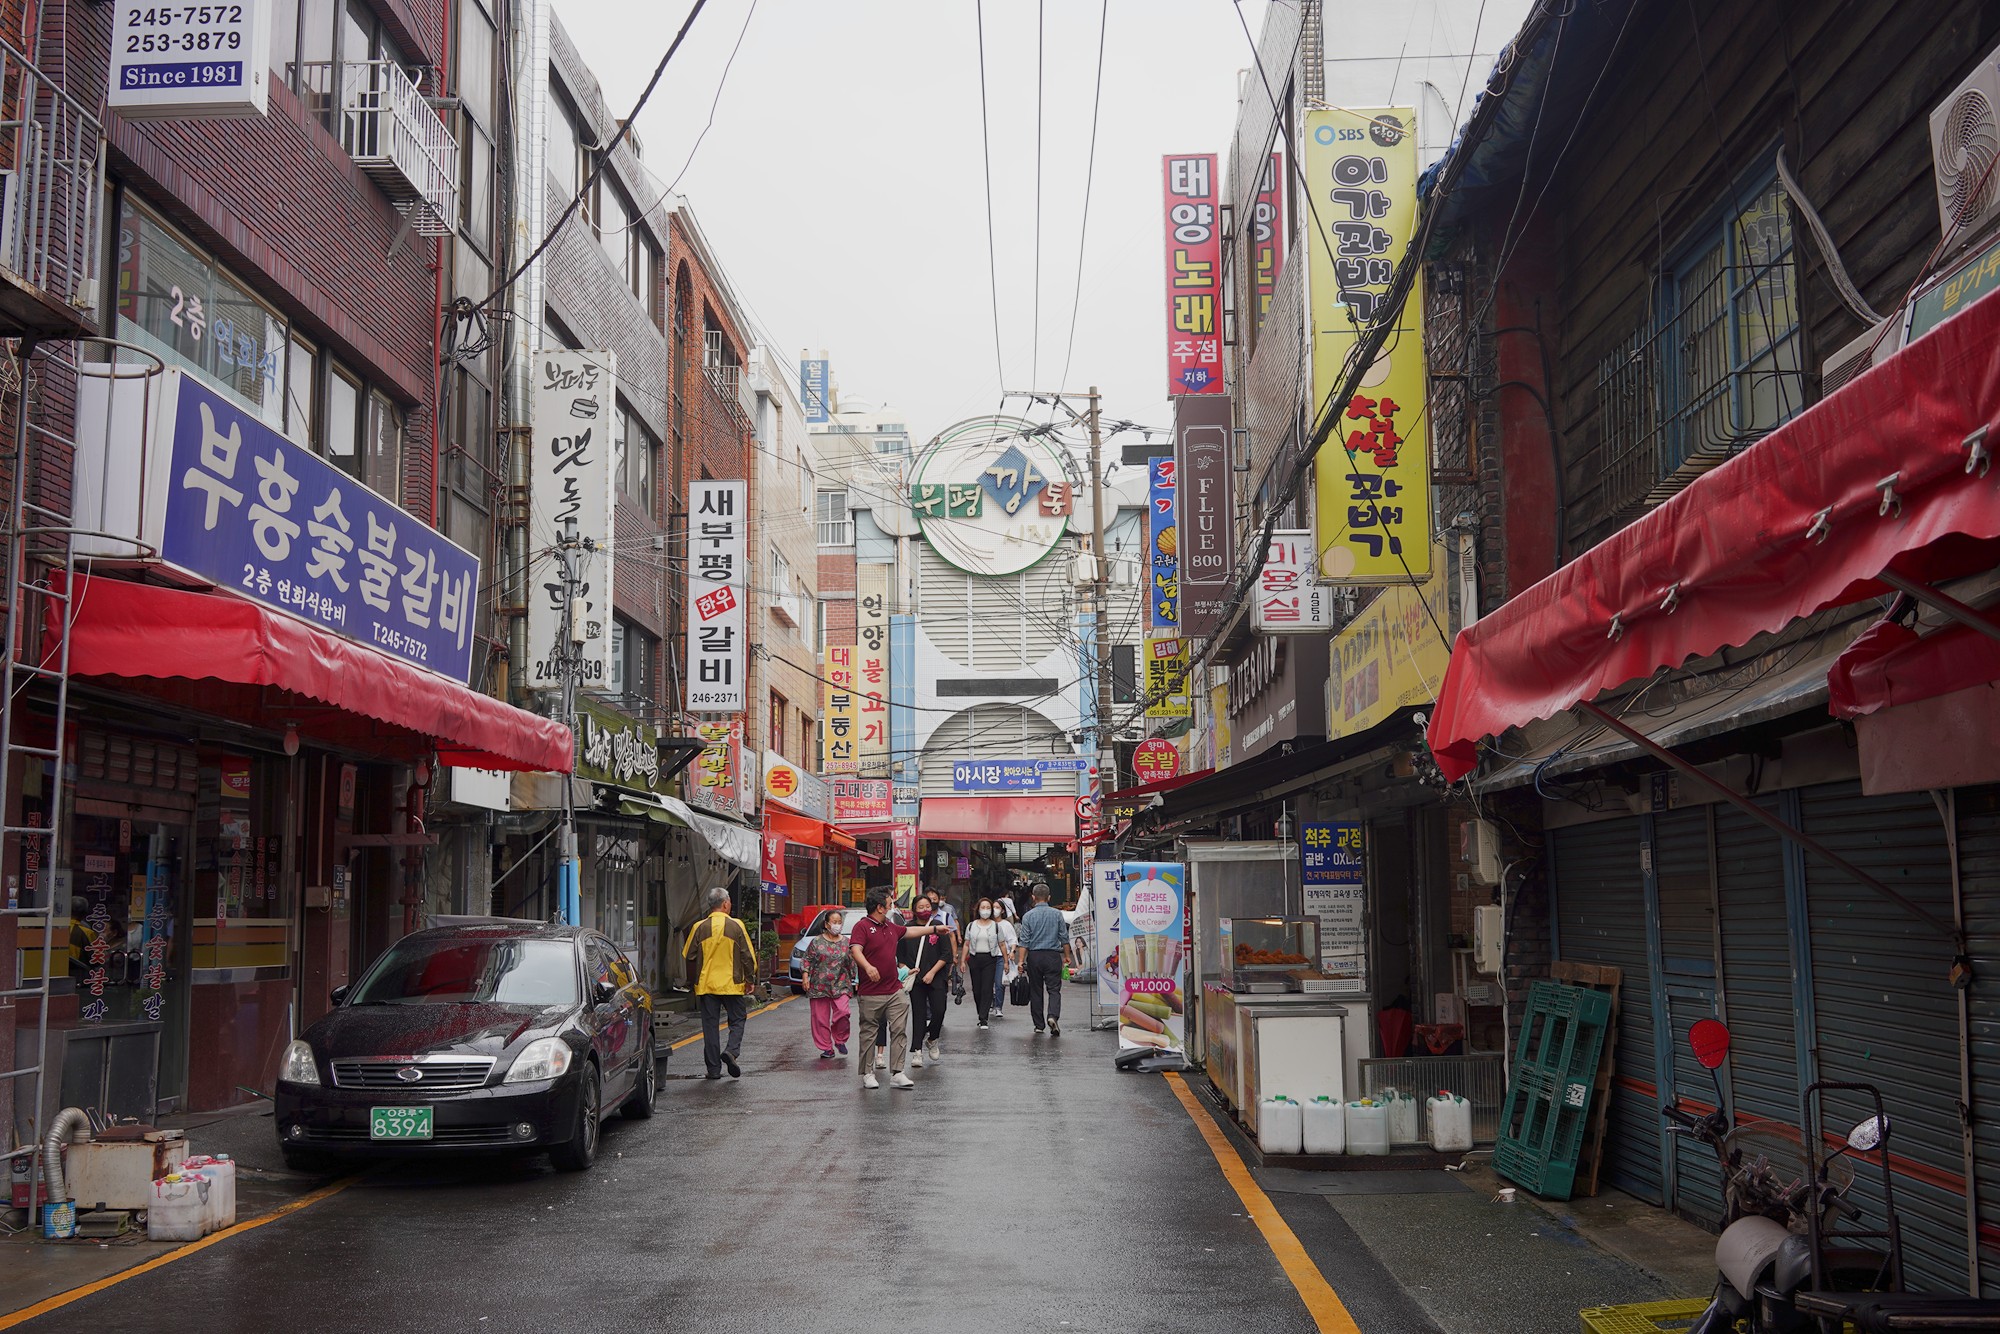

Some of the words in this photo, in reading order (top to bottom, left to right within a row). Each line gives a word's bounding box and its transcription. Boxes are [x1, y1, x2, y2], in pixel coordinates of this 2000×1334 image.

[128, 5, 242, 27] 245-7572
[126, 31, 241, 53] 253-3879
[125, 66, 186, 87] Since
[190, 65, 238, 85] 1981
[1339, 129, 1364, 140] SBS
[170, 285, 206, 341] 2층
[214, 318, 277, 394] 연회석
[1172, 340, 1217, 363] 주점
[543, 361, 599, 392] 부평동
[1185, 371, 1207, 383] 지하
[1345, 394, 1404, 469] 찹쌀
[914, 486, 982, 517] 부평
[1198, 478, 1214, 550] FLUE
[1345, 473, 1403, 558] 꽈배기
[182, 401, 470, 651] 부흥숯불갈비
[699, 490, 734, 581] 새부평
[1192, 555, 1222, 567] 800
[1263, 542, 1301, 622] 미용실
[242, 564, 272, 598] 2층
[278, 577, 347, 627] 연회석완비
[373, 621, 428, 662] T.245-7572
[698, 589, 734, 619] 한우
[699, 626, 734, 685] 갈비
[1155, 641, 1179, 656] 김해
[692, 692, 738, 703] 246-2371
[831, 648, 852, 759] 대한부동산
[1148, 742, 1165, 751] 향미
[1137, 752, 1176, 769] 족발
[771, 770, 792, 792] 죽
[956, 766, 1001, 785] 야시장
[692, 788, 737, 811] 노래주점
[834, 783, 888, 798] 고대방출
[1305, 828, 1331, 848] 척추
[1306, 853, 1324, 866] 골반
[1135, 893, 1167, 902] 본젤라또
[1132, 905, 1171, 914] 아이스크림
[1130, 981, 1171, 993] ₩1,000
[374, 1118, 430, 1136] 8394
